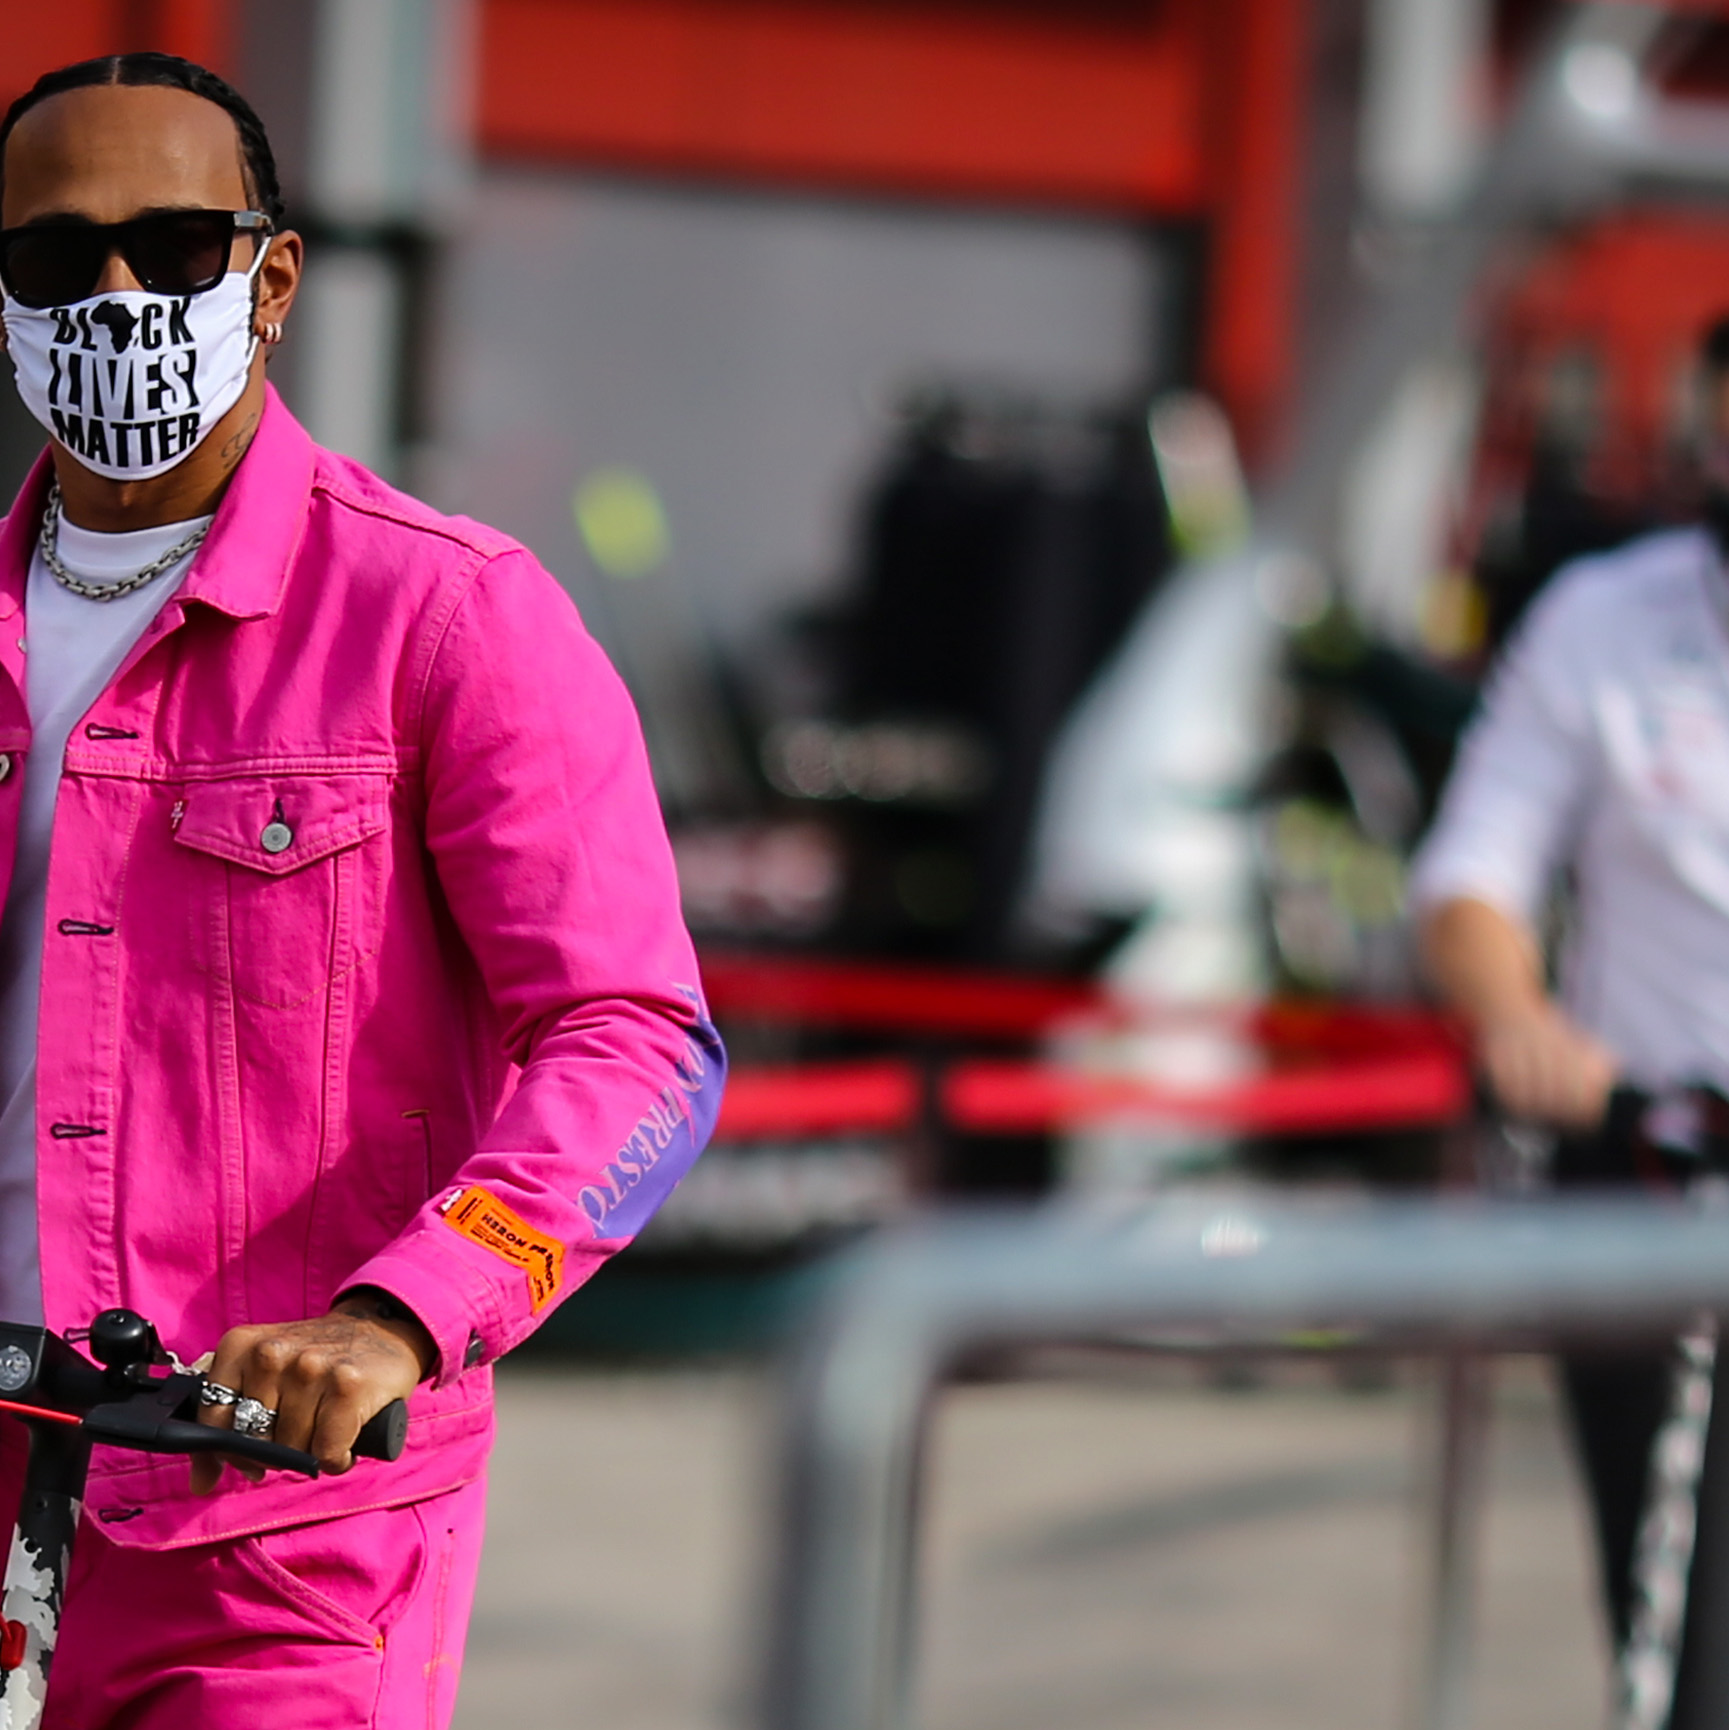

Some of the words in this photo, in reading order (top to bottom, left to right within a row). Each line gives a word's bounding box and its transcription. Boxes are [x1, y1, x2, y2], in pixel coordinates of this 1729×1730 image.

[49, 349, 200, 420] LIVES
[51, 410, 200, 468] MATTER
[576, 1087, 685, 1239] PRESTO
